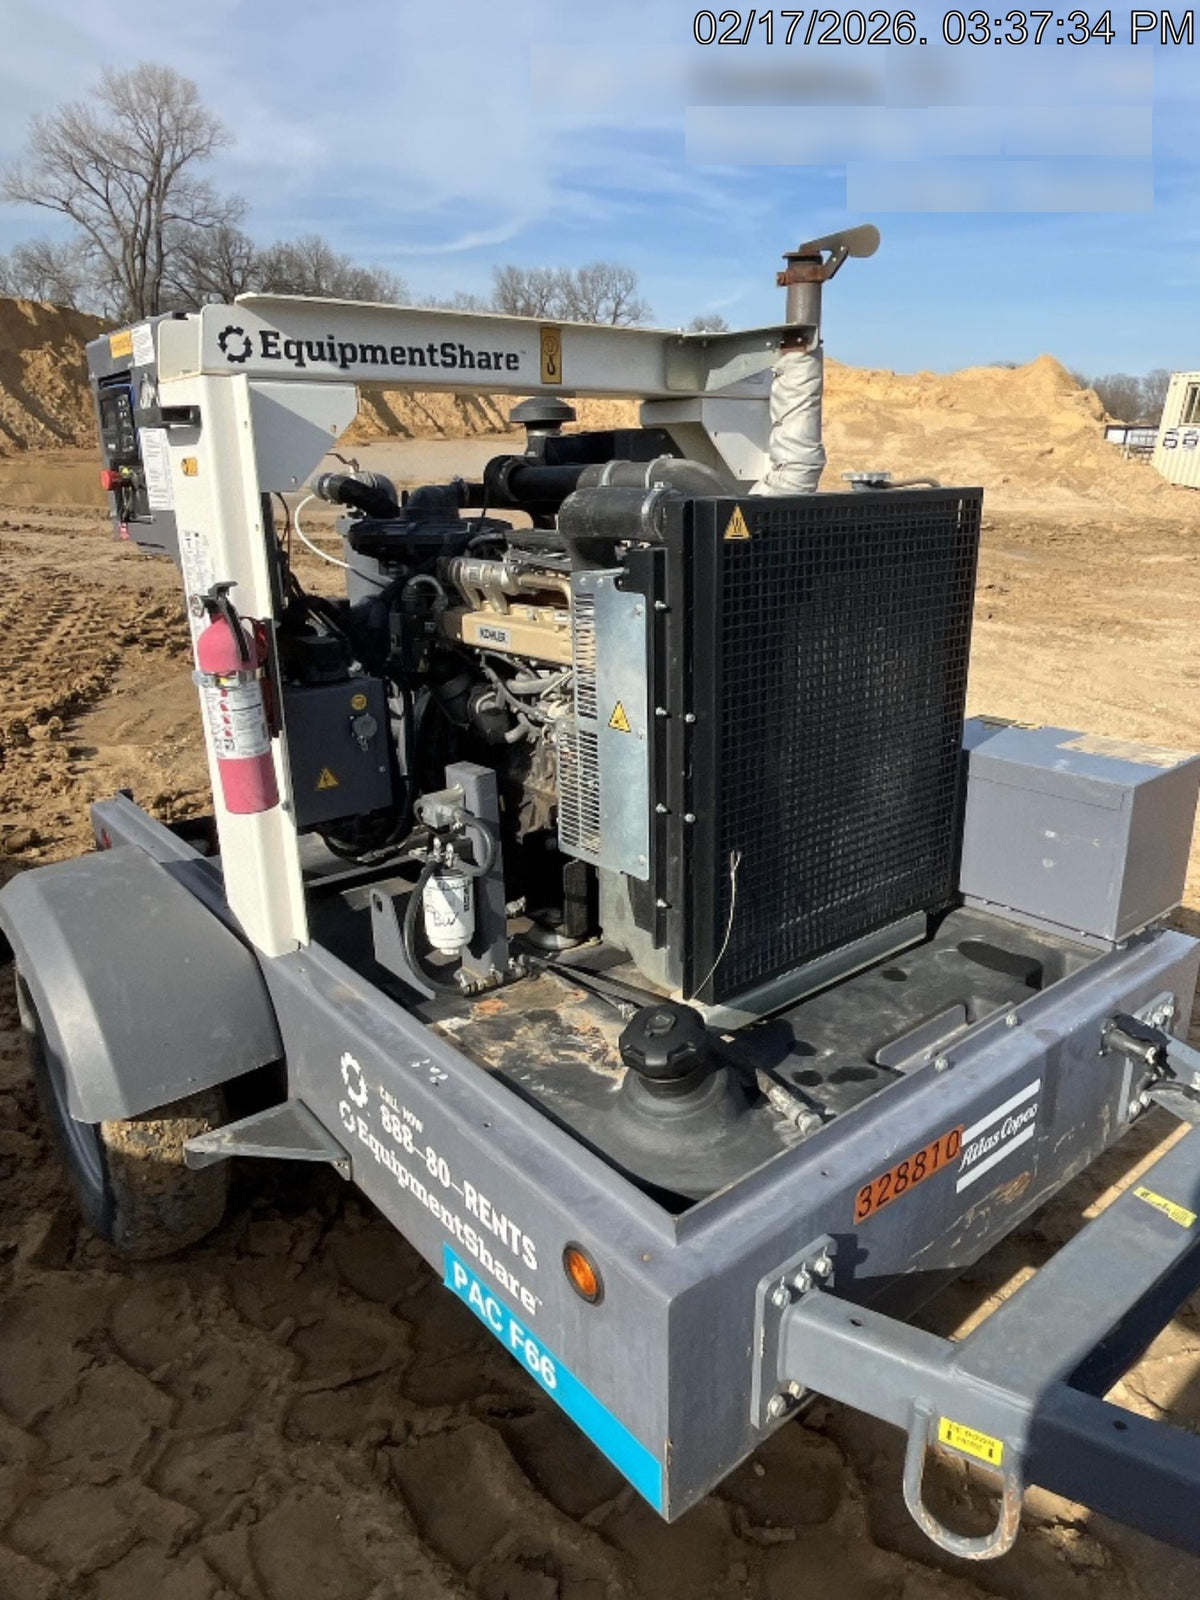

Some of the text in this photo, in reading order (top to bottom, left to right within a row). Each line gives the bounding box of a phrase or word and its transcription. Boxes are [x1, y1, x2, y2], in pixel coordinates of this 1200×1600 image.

[258, 329, 521, 371] EquipmentShare
[857, 1129, 960, 1218] 328810
[958, 1103, 1039, 1173] Atlas Copco
[356, 1115, 538, 1317] EquipmentShare
[453, 1260, 558, 1390] PAC F66
